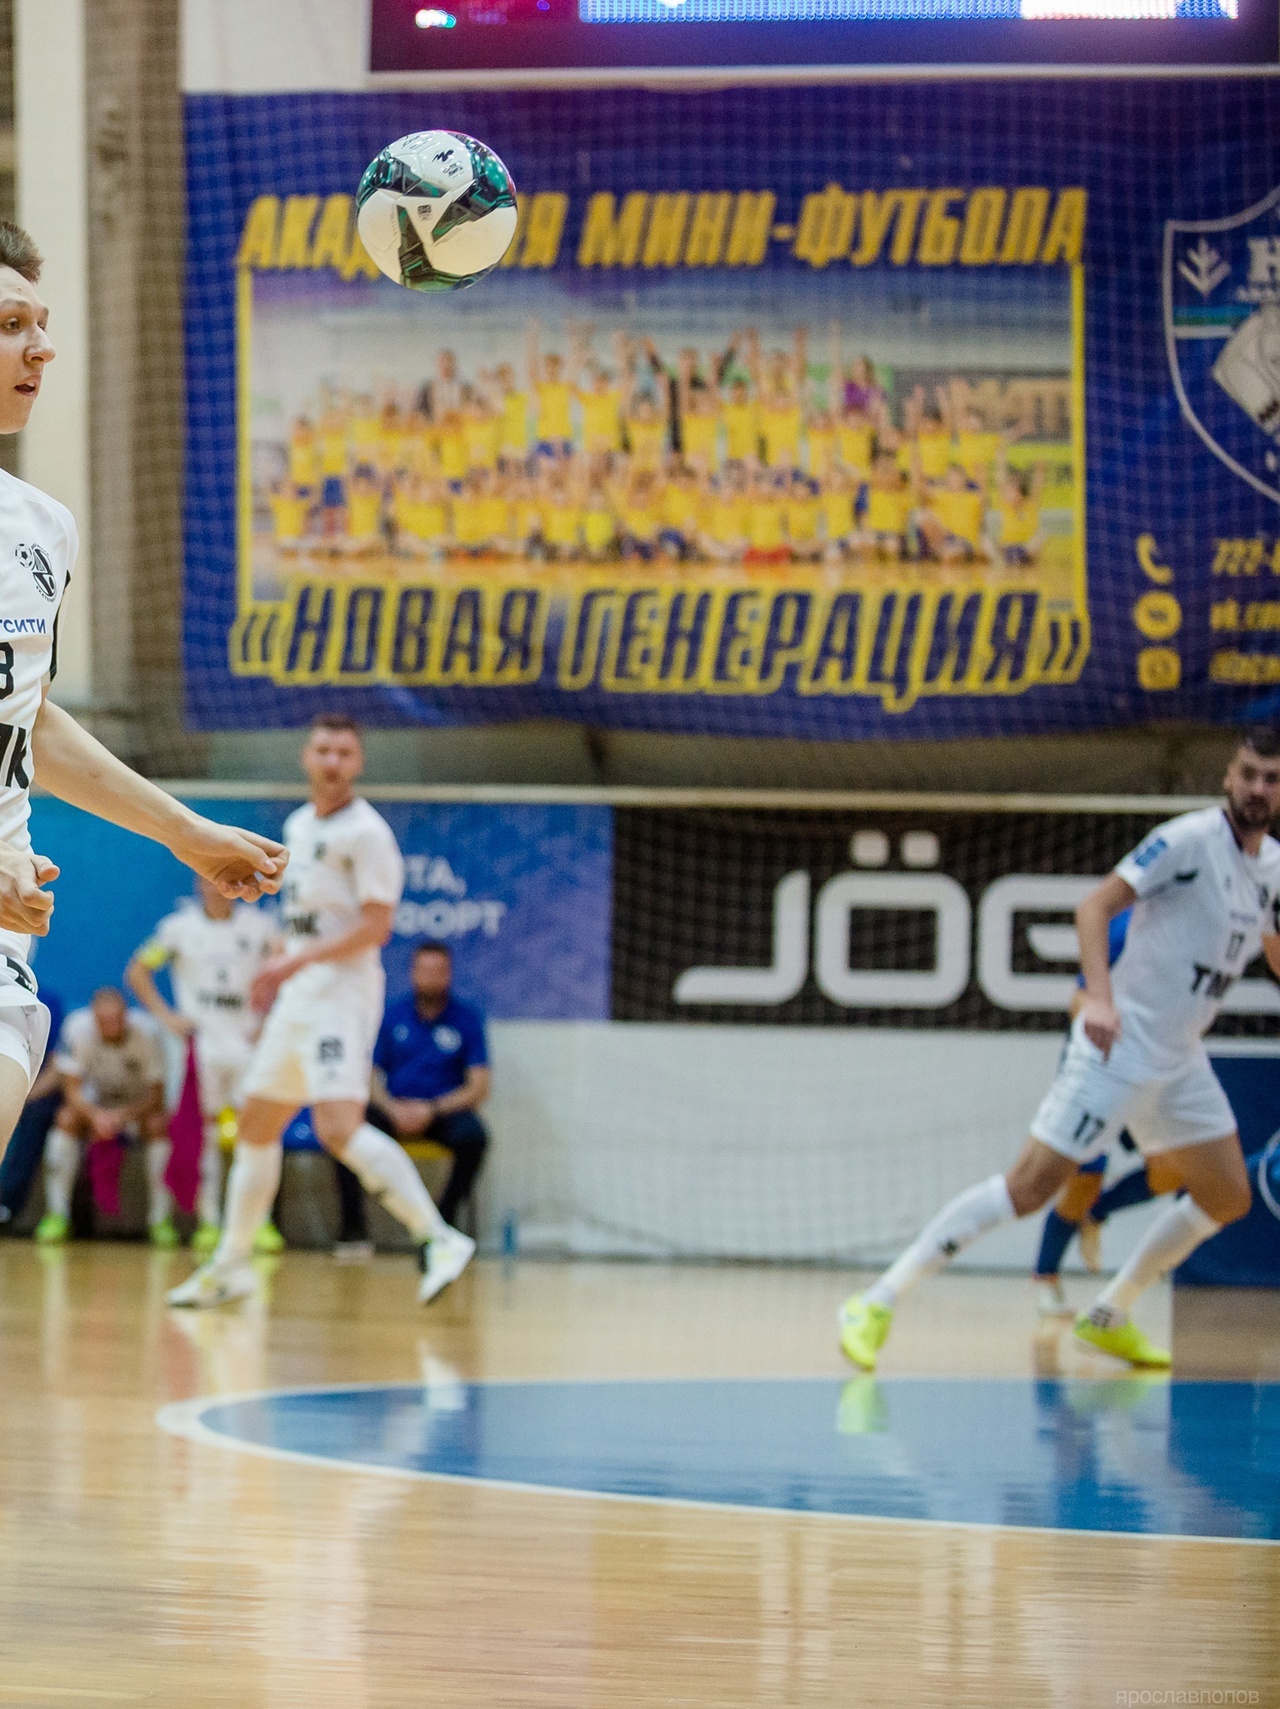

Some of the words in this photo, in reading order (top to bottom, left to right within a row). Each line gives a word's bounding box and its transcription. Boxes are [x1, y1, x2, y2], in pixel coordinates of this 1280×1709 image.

[237, 192, 568, 280] АКАДЯ
[578, 182, 1088, 268] МИНИ-ФУТБОЛА
[1073, 1111, 1106, 1148] 17
